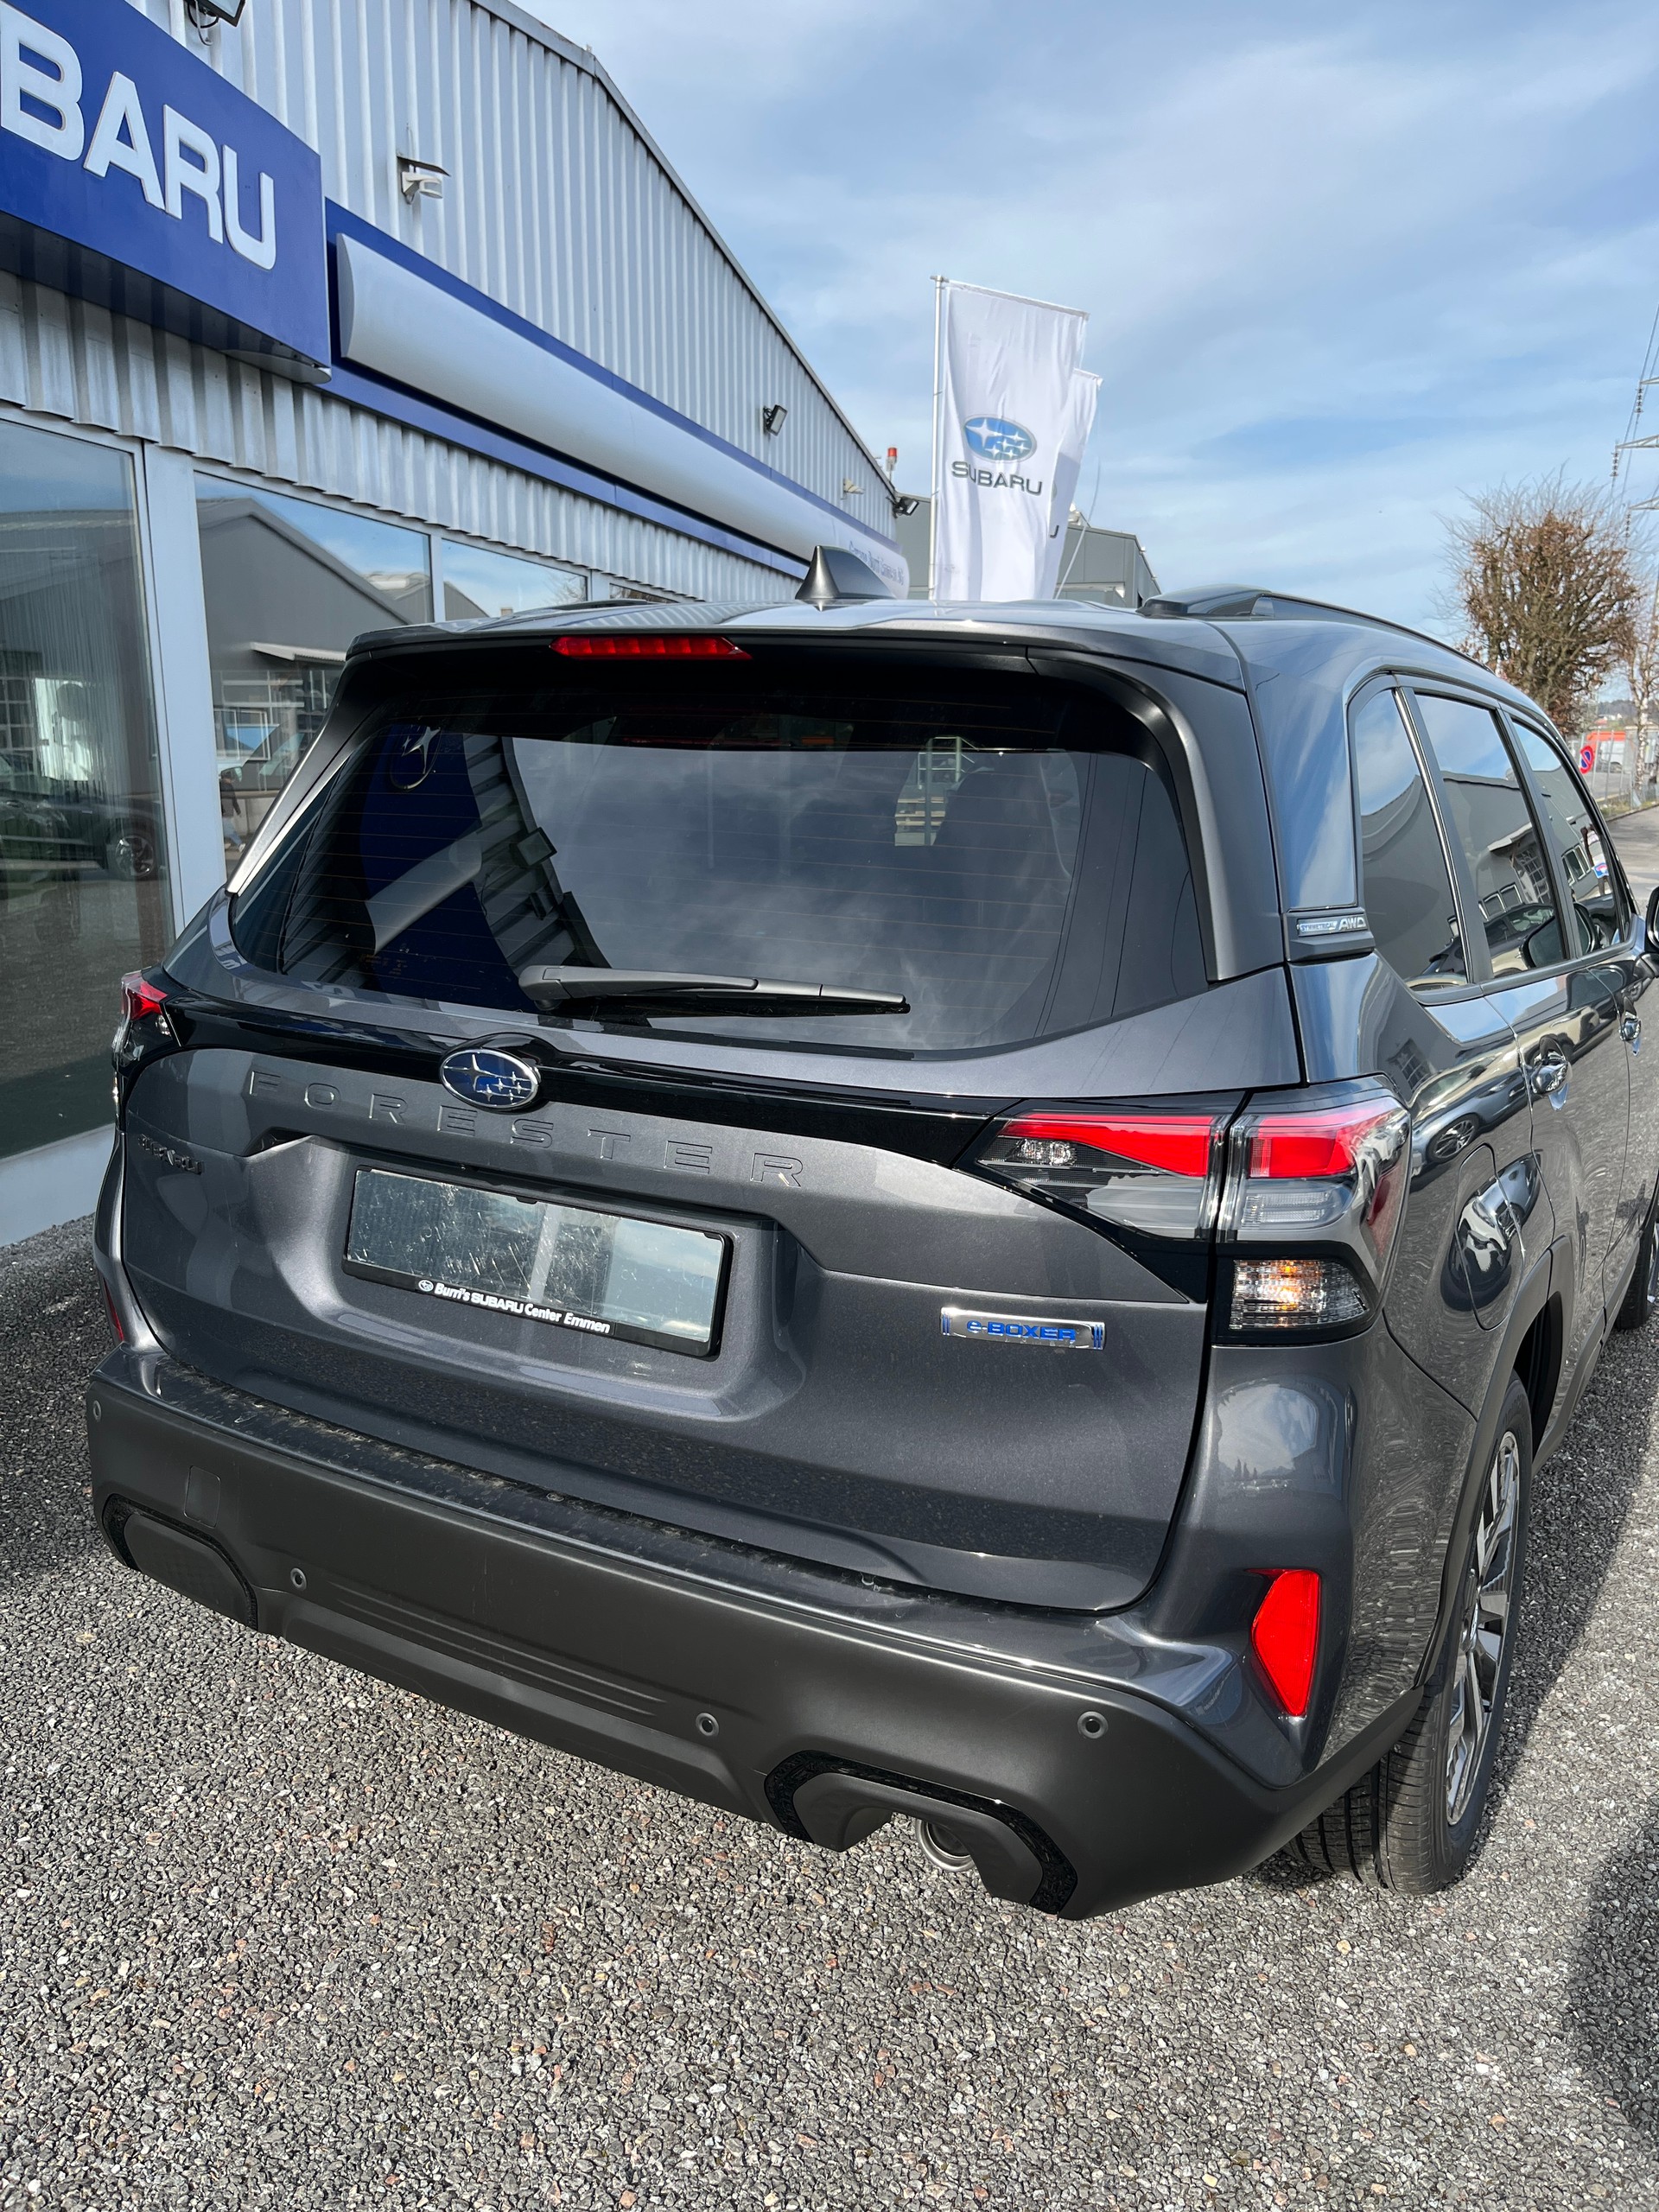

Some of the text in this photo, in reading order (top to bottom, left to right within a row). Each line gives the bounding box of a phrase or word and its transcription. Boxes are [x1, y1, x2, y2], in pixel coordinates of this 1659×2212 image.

[950, 461, 1043, 496] SUBARU
[1338, 916, 1366, 931] AWD
[248, 1070, 804, 1188] FORESTER
[434, 1282, 611, 1334] Burri's SUBARU Center Emmen
[966, 1319, 1077, 1343] e-BOXER
